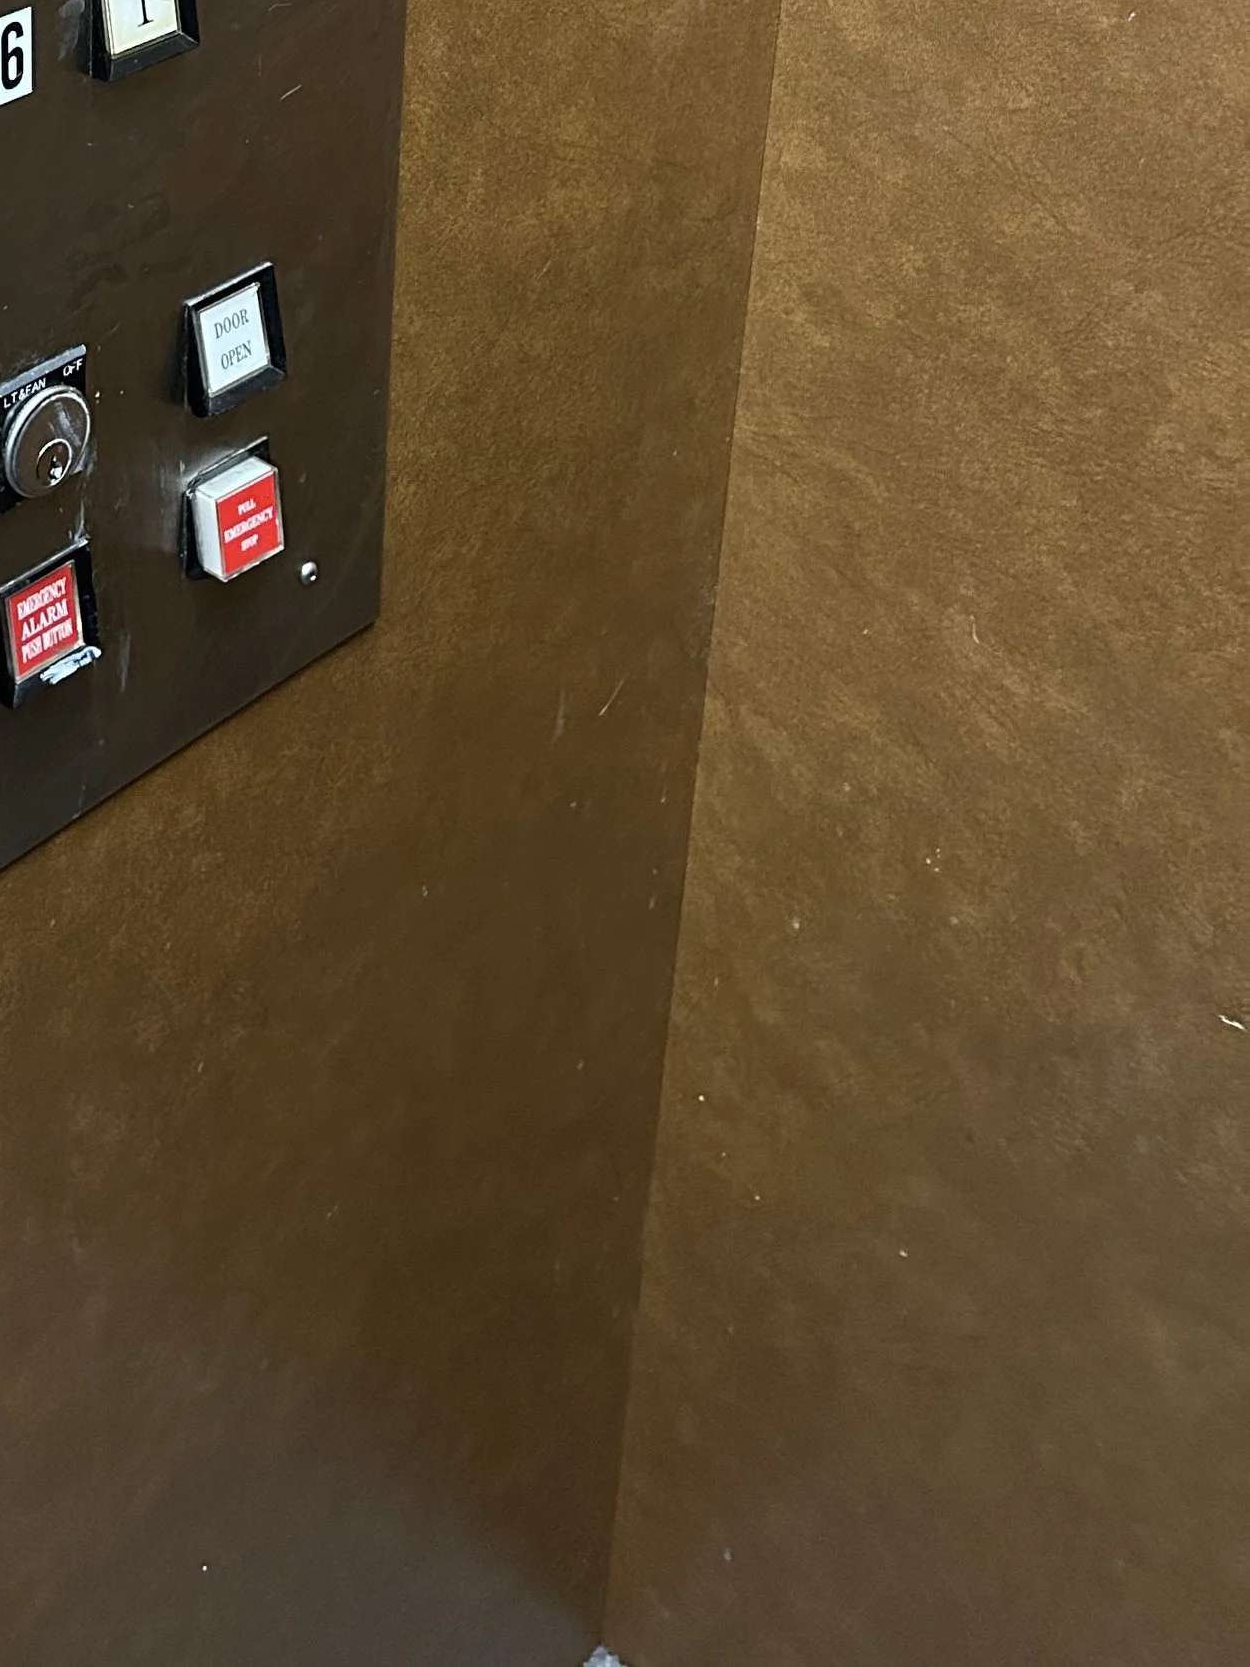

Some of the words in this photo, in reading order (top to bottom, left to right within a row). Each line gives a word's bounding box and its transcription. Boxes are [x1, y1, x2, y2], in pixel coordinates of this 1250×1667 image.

[213, 308, 250, 340] DOOR
[62, 358, 84, 377] OFF
[220, 340, 253, 370] OPEN
[237, 498, 257, 516] PULL
[223, 506, 274, 544] EMERGENCY
[240, 533, 259, 552] STOP
[16, 576, 67, 621] EMERGENCY
[21, 598, 69, 642] ALARM
[21, 635, 43, 664] PUSH
[42, 617, 74, 651] BUTTON
